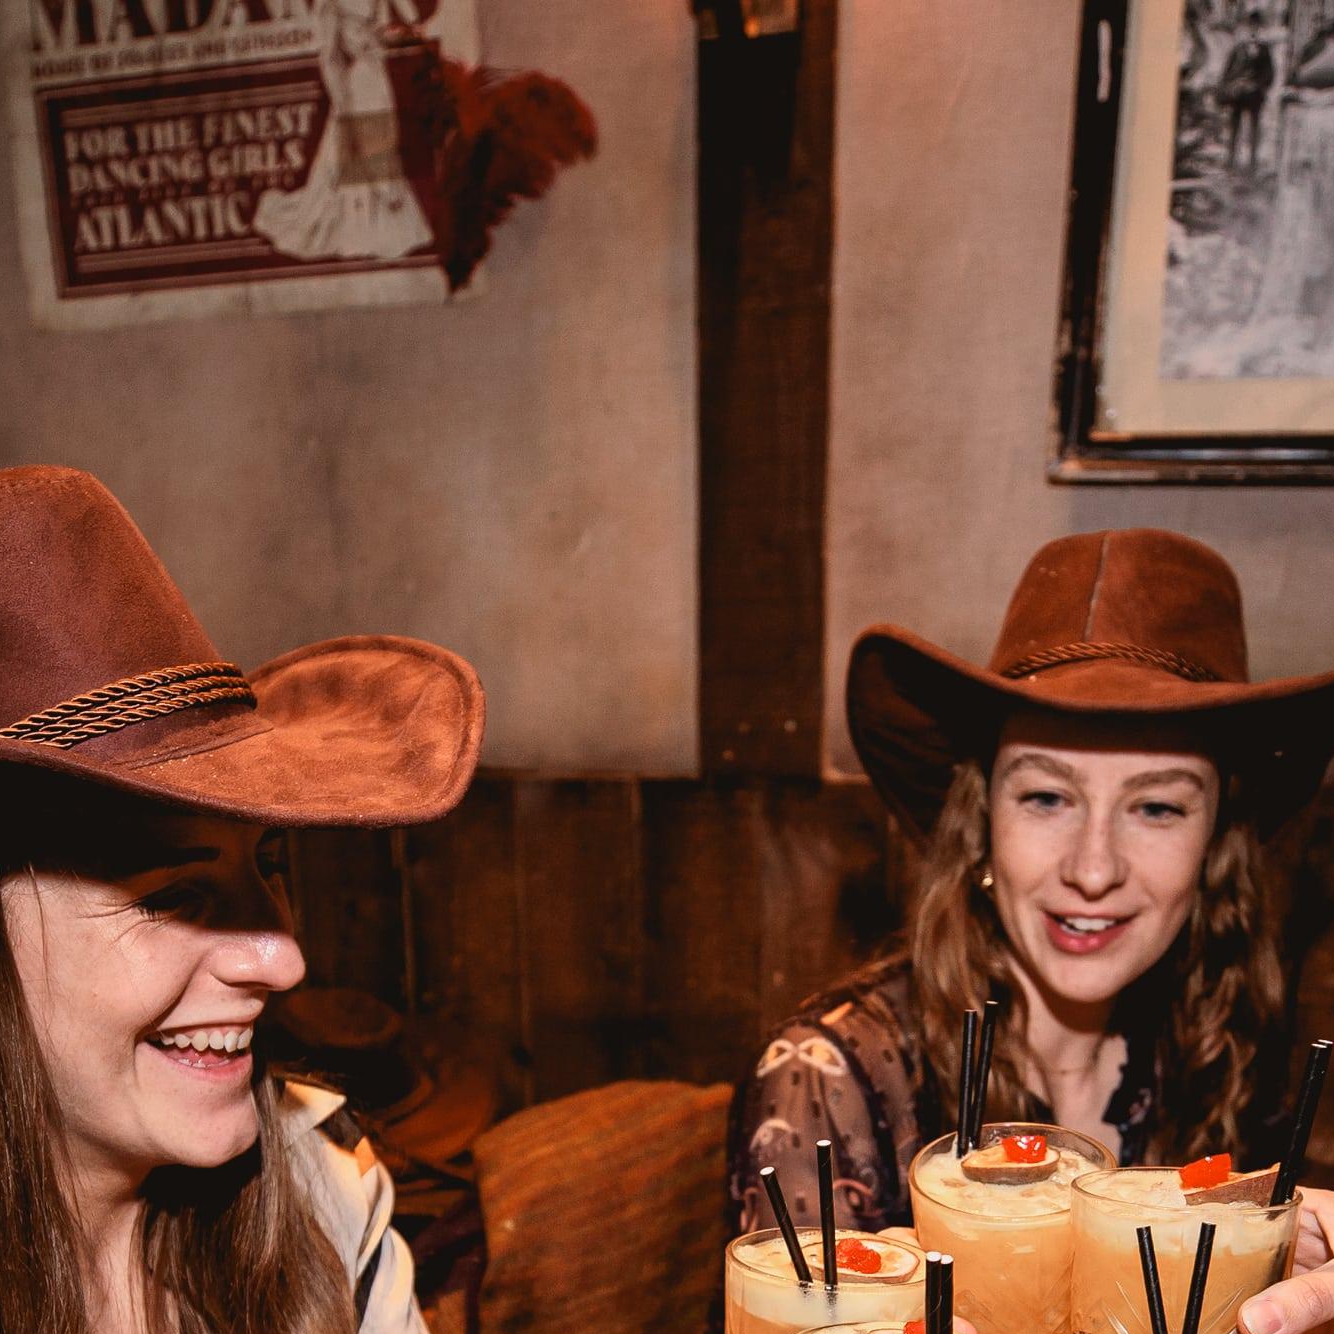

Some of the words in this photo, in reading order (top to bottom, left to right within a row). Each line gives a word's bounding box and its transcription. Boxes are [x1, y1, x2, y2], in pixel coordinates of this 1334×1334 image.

[64, 127, 128, 160] FOR
[134, 115, 199, 151] THE
[203, 103, 318, 146] FINEST
[67, 149, 204, 194] DANCING
[208, 138, 306, 177] GIRLS
[74, 190, 252, 252] ATLANTIC
